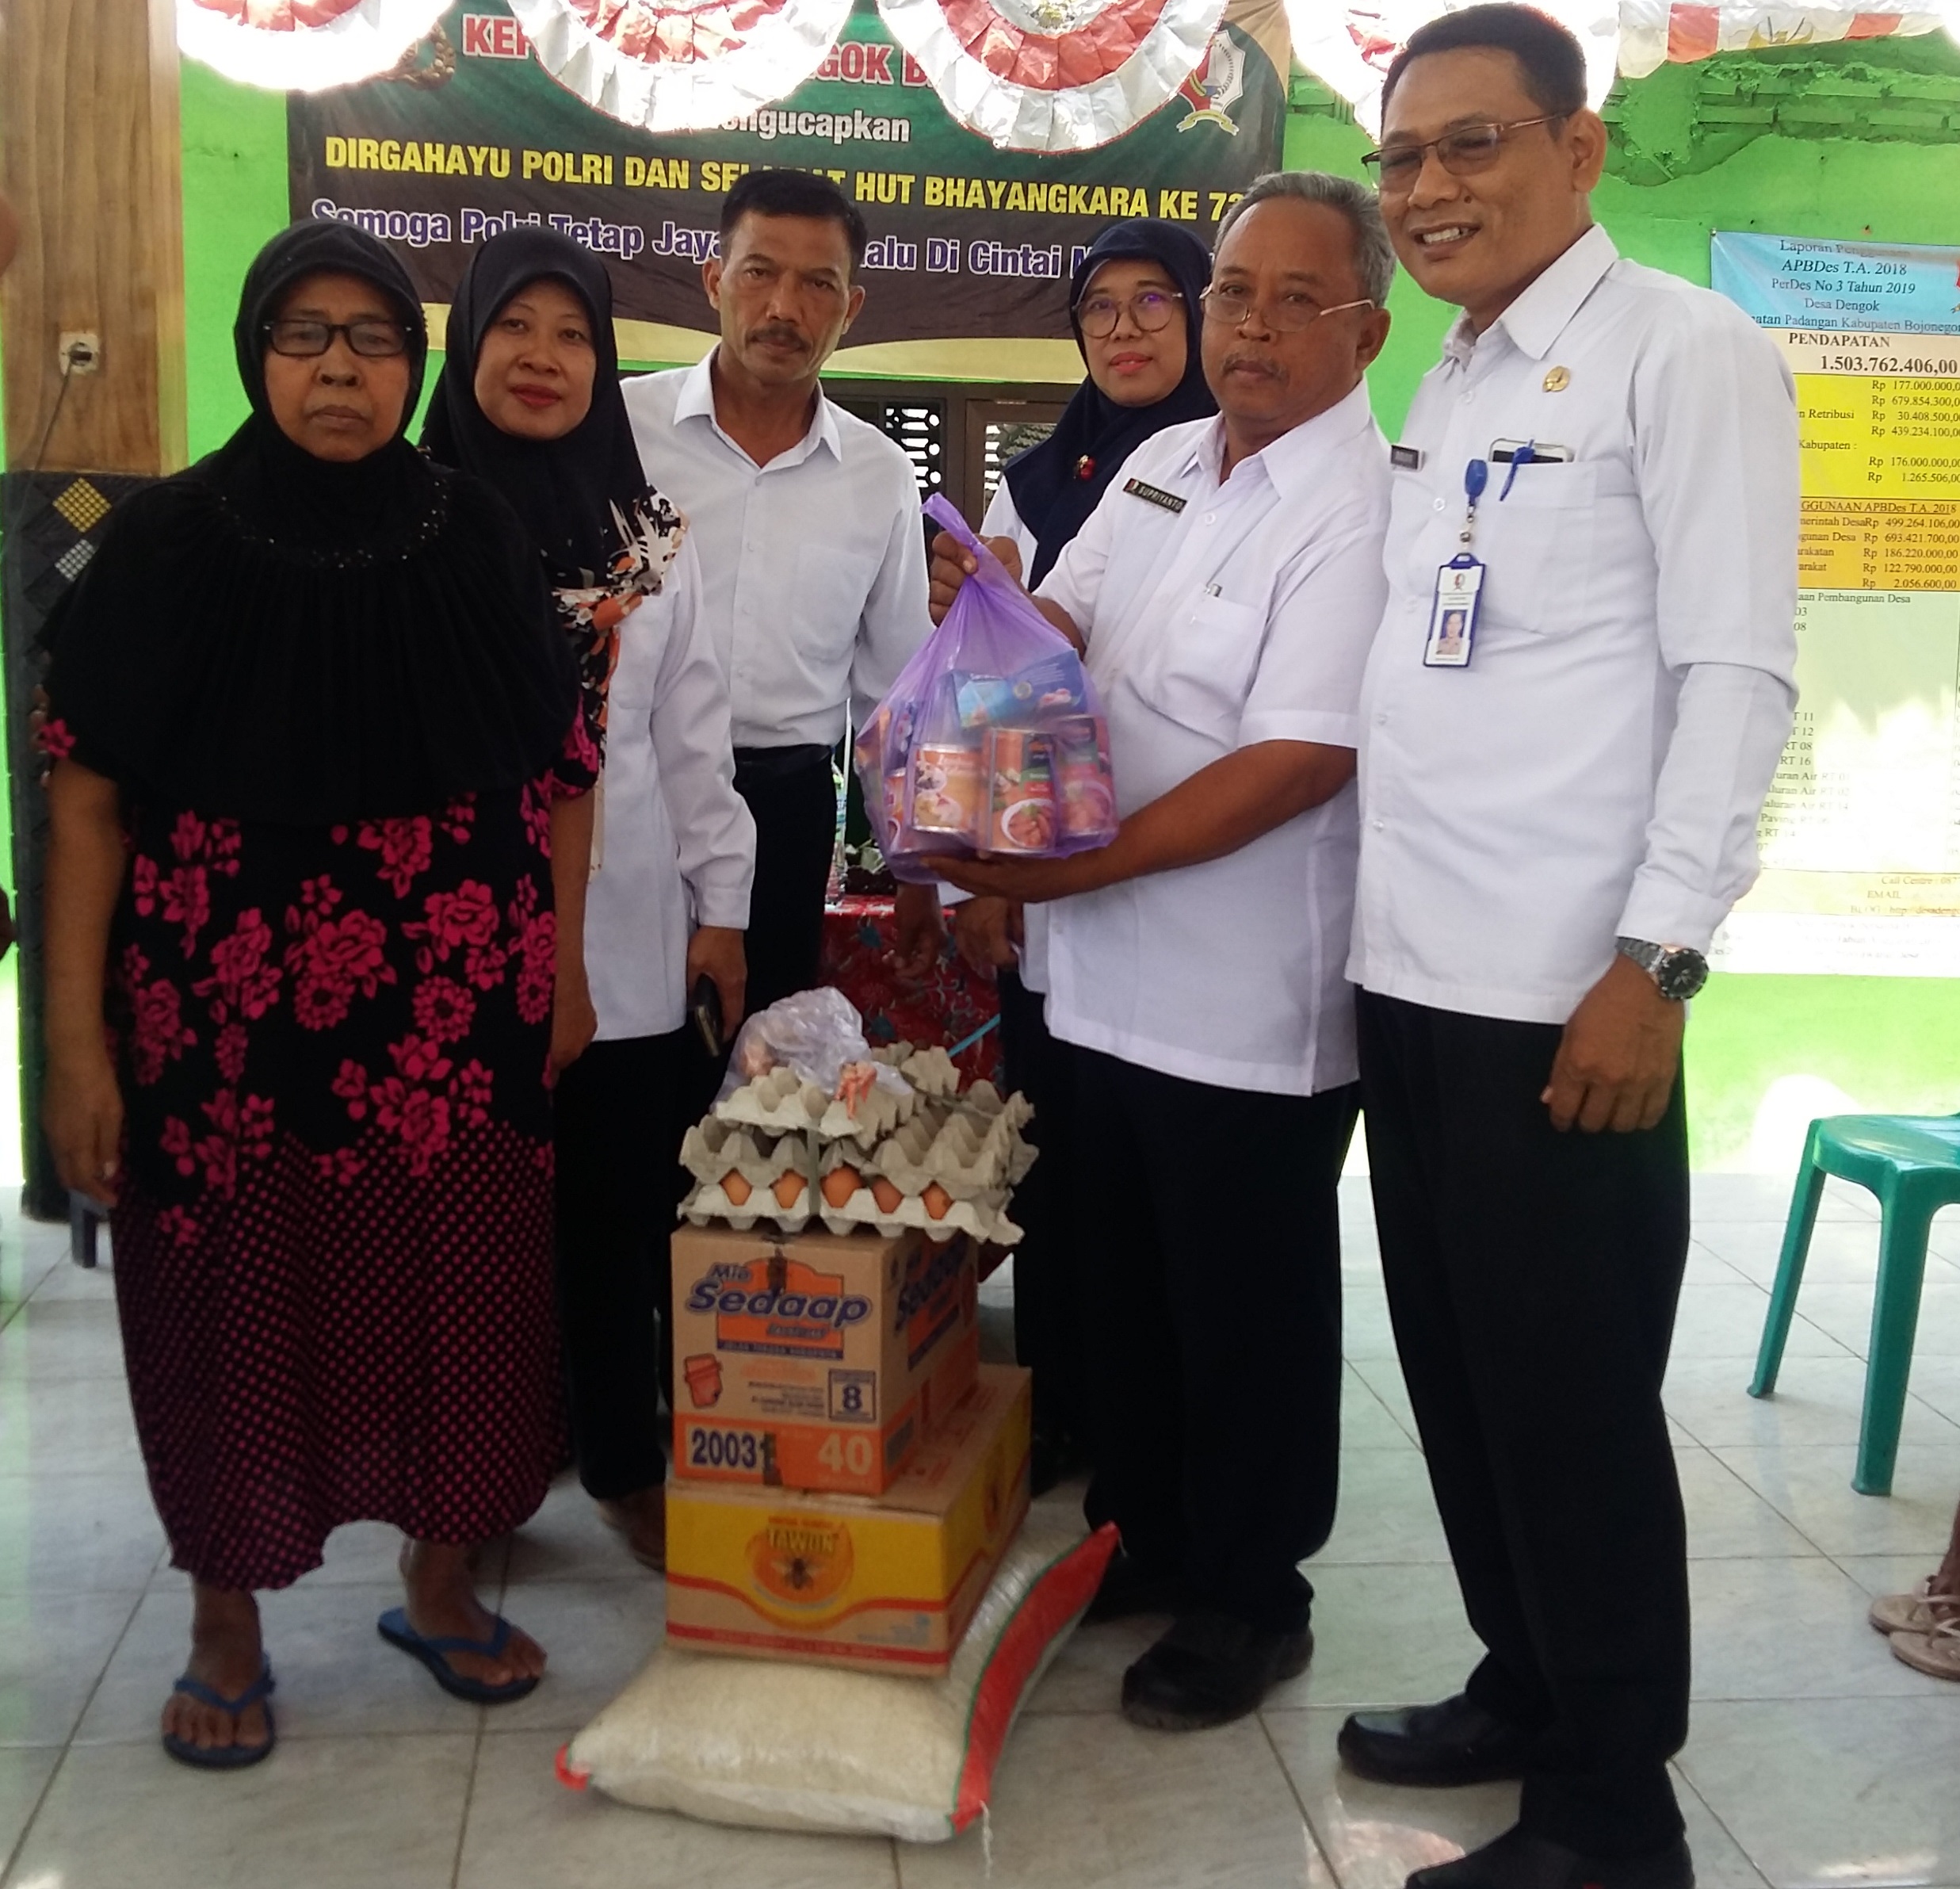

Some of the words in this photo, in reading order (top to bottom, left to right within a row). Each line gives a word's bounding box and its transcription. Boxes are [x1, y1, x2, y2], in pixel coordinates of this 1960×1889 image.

[810, 42, 894, 85] GOK
[326, 136, 510, 178] DIRGAHAYU
[523, 150, 613, 185] POLRI
[625, 156, 690, 189] DAN
[855, 172, 915, 205] HUT
[925, 176, 1150, 218] BHAYANGKARA
[1159, 189, 1198, 220] KE
[548, 213, 644, 260] Tetap
[860, 235, 916, 270] alu
[927, 238, 960, 273] Di
[969, 240, 1062, 278] Cintai
[1780, 240, 1832, 254] Laporan
[1782, 259, 1839, 273] APBDes
[1843, 261, 1870, 274] T.A.
[1875, 262, 1907, 275] 2018
[1771, 278, 1811, 290] PerDes
[1815, 280, 1832, 291] No
[1836, 280, 1843, 292] 3
[1847, 281, 1882, 293] Tahun
[1886, 282, 1916, 294] 2019
[1805, 298, 1832, 309] Desa
[1836, 299, 1880, 313] Dengok
[1786, 314, 1837, 329] Padangan
[1841, 317, 1901, 331] Kabupaten
[1789, 332, 1890, 347] PENDAPATAN
[1821, 356, 1958, 376] 1.503.762.406,00
[1872, 380, 1885, 392] Rp
[1871, 396, 1885, 407] Rp
[1808, 408, 1855, 419] Retribusi
[1872, 411, 1885, 422] Rp
[1871, 426, 1885, 438] Rp
[1869, 456, 1883, 468] Rp
[1867, 472, 1882, 483] Rp
[1138, 486, 1183, 510] SUPRIYANTO
[1864, 503, 1906, 512] APBDes
[1933, 503, 1957, 514] 2018
[1832, 532, 1856, 541] Desa
[1864, 533, 1878, 545] Rp
[1885, 533, 1959, 544] 693.421.700,00
[1863, 548, 1878, 560] Rp
[1885, 548, 1958, 559] 186.220.000,00
[1863, 563, 1877, 575] Rp
[1885, 563, 1958, 574] 122.790.000,00
[1863, 578, 1876, 589] Rp
[1894, 579, 1957, 590] 2.056.600,00
[1818, 593, 1885, 604] Pembangunan
[1888, 594, 1911, 602] Desa
[1803, 727, 1814, 736] 12
[1799, 742, 1813, 751] 08
[1780, 755, 1795, 765] RT
[686, 1280, 873, 1330] Sedaap
[842, 1383, 863, 1413] 8
[818, 1432, 873, 1476] 40
